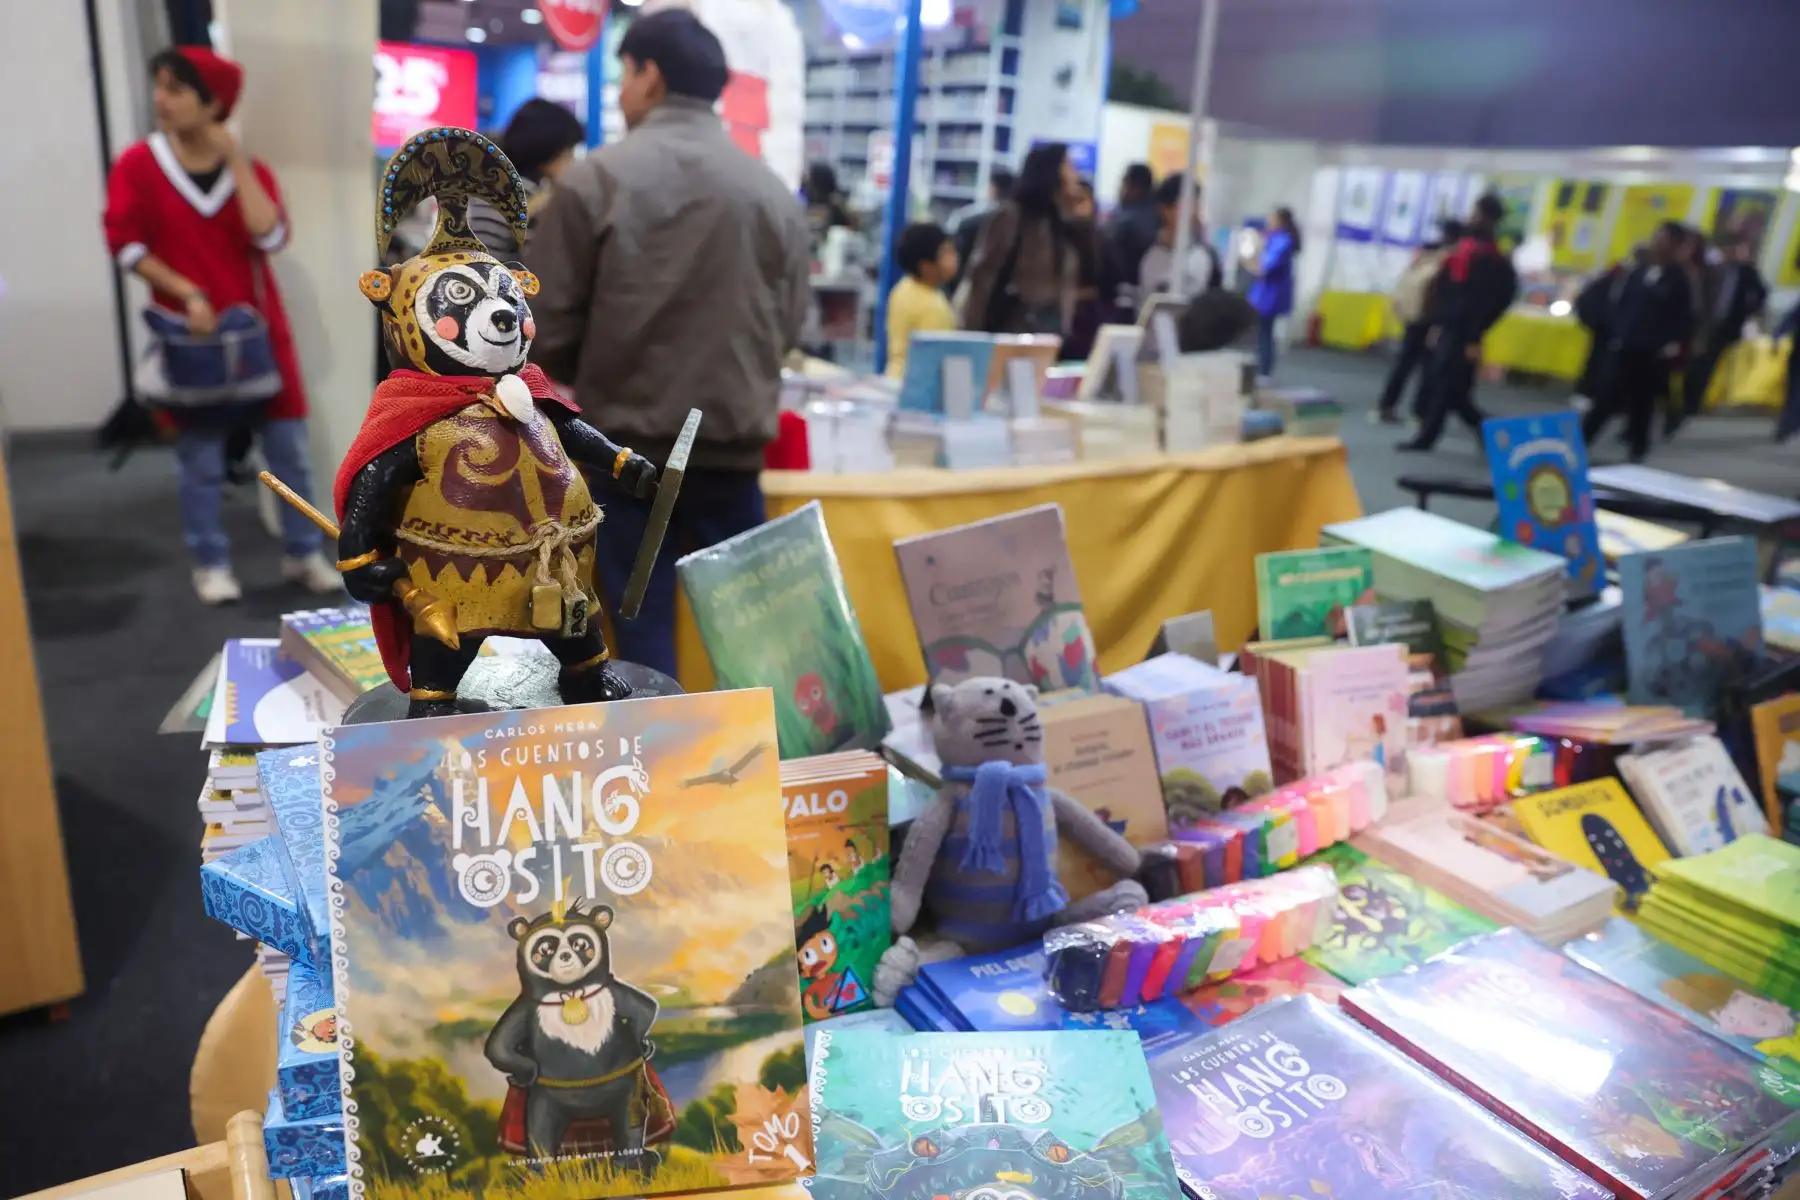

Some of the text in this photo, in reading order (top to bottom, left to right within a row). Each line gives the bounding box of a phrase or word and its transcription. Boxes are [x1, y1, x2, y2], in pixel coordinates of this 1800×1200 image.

[448, 736, 642, 771] LOS CUENTOS DE
[484, 720, 599, 739] CARLOS MERA
[453, 757, 650, 849] HANG
[453, 842, 652, 907] OSITO
[900, 1058, 1048, 1097] HANG
[1171, 1066, 1199, 1084] LOS
[1201, 1038, 1259, 1070] CUENTOS
[1187, 1040, 1310, 1116] HANG
[899, 1094, 1052, 1124] OSITO
[1226, 1074, 1347, 1138] OSITO
[748, 1111, 811, 1172] TOMO 1
